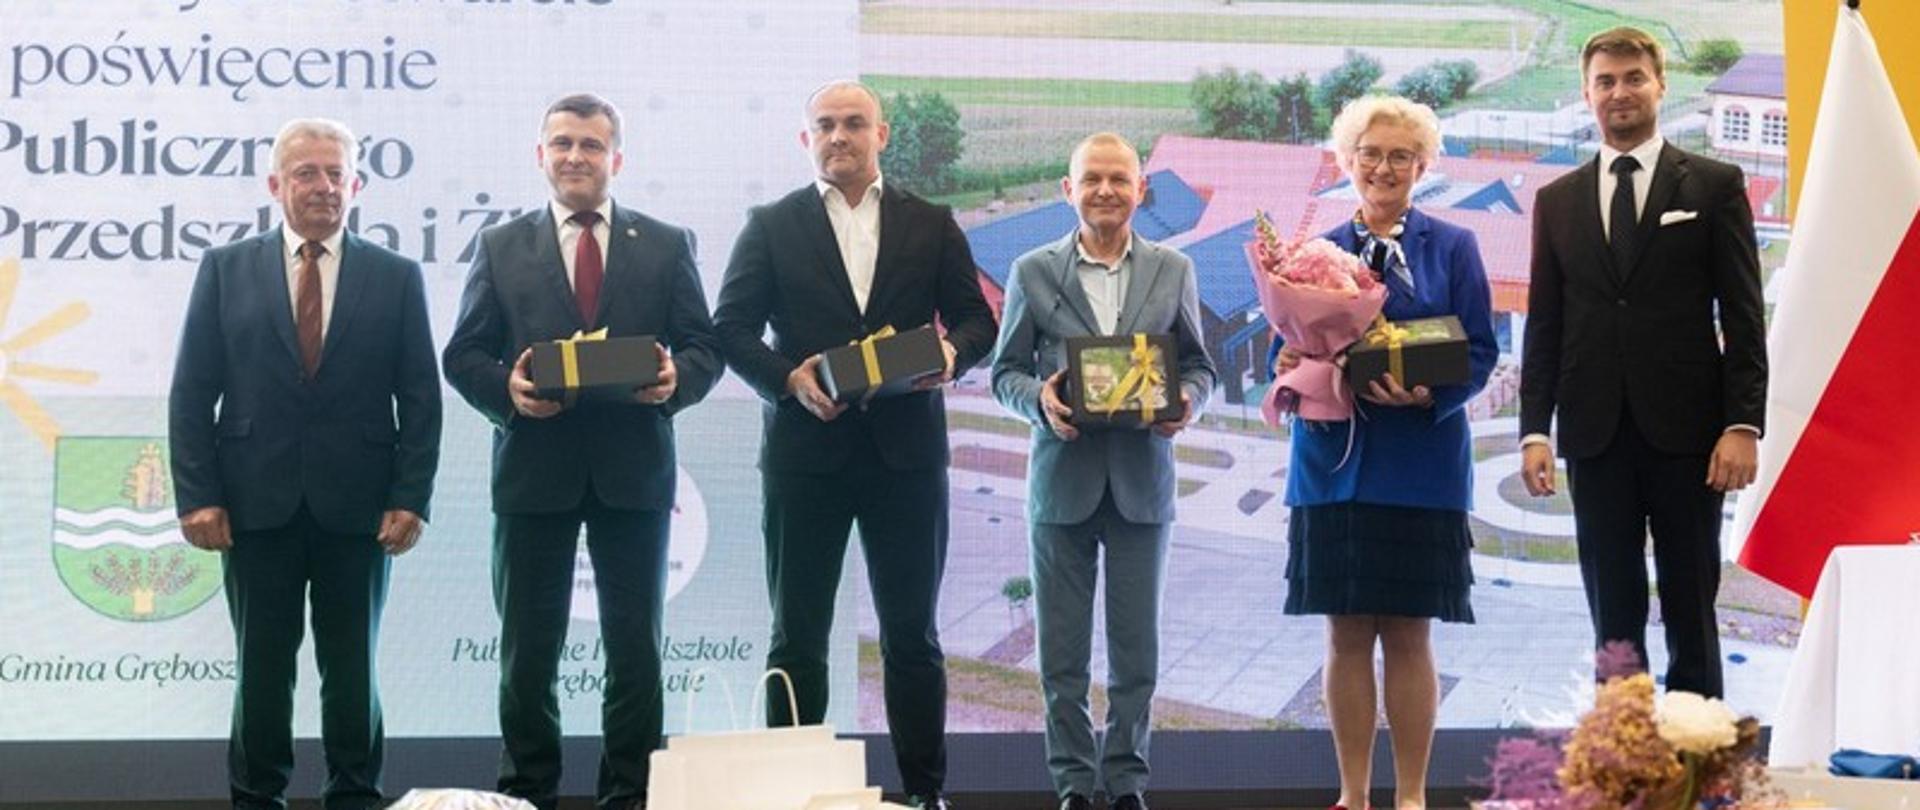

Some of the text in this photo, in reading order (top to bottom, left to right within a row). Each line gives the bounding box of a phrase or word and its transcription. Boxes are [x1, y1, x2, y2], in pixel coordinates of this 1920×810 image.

[10, 30, 438, 102] poświęcenie
[422, 207, 438, 263] i
[0, 654, 107, 682] Gmina
